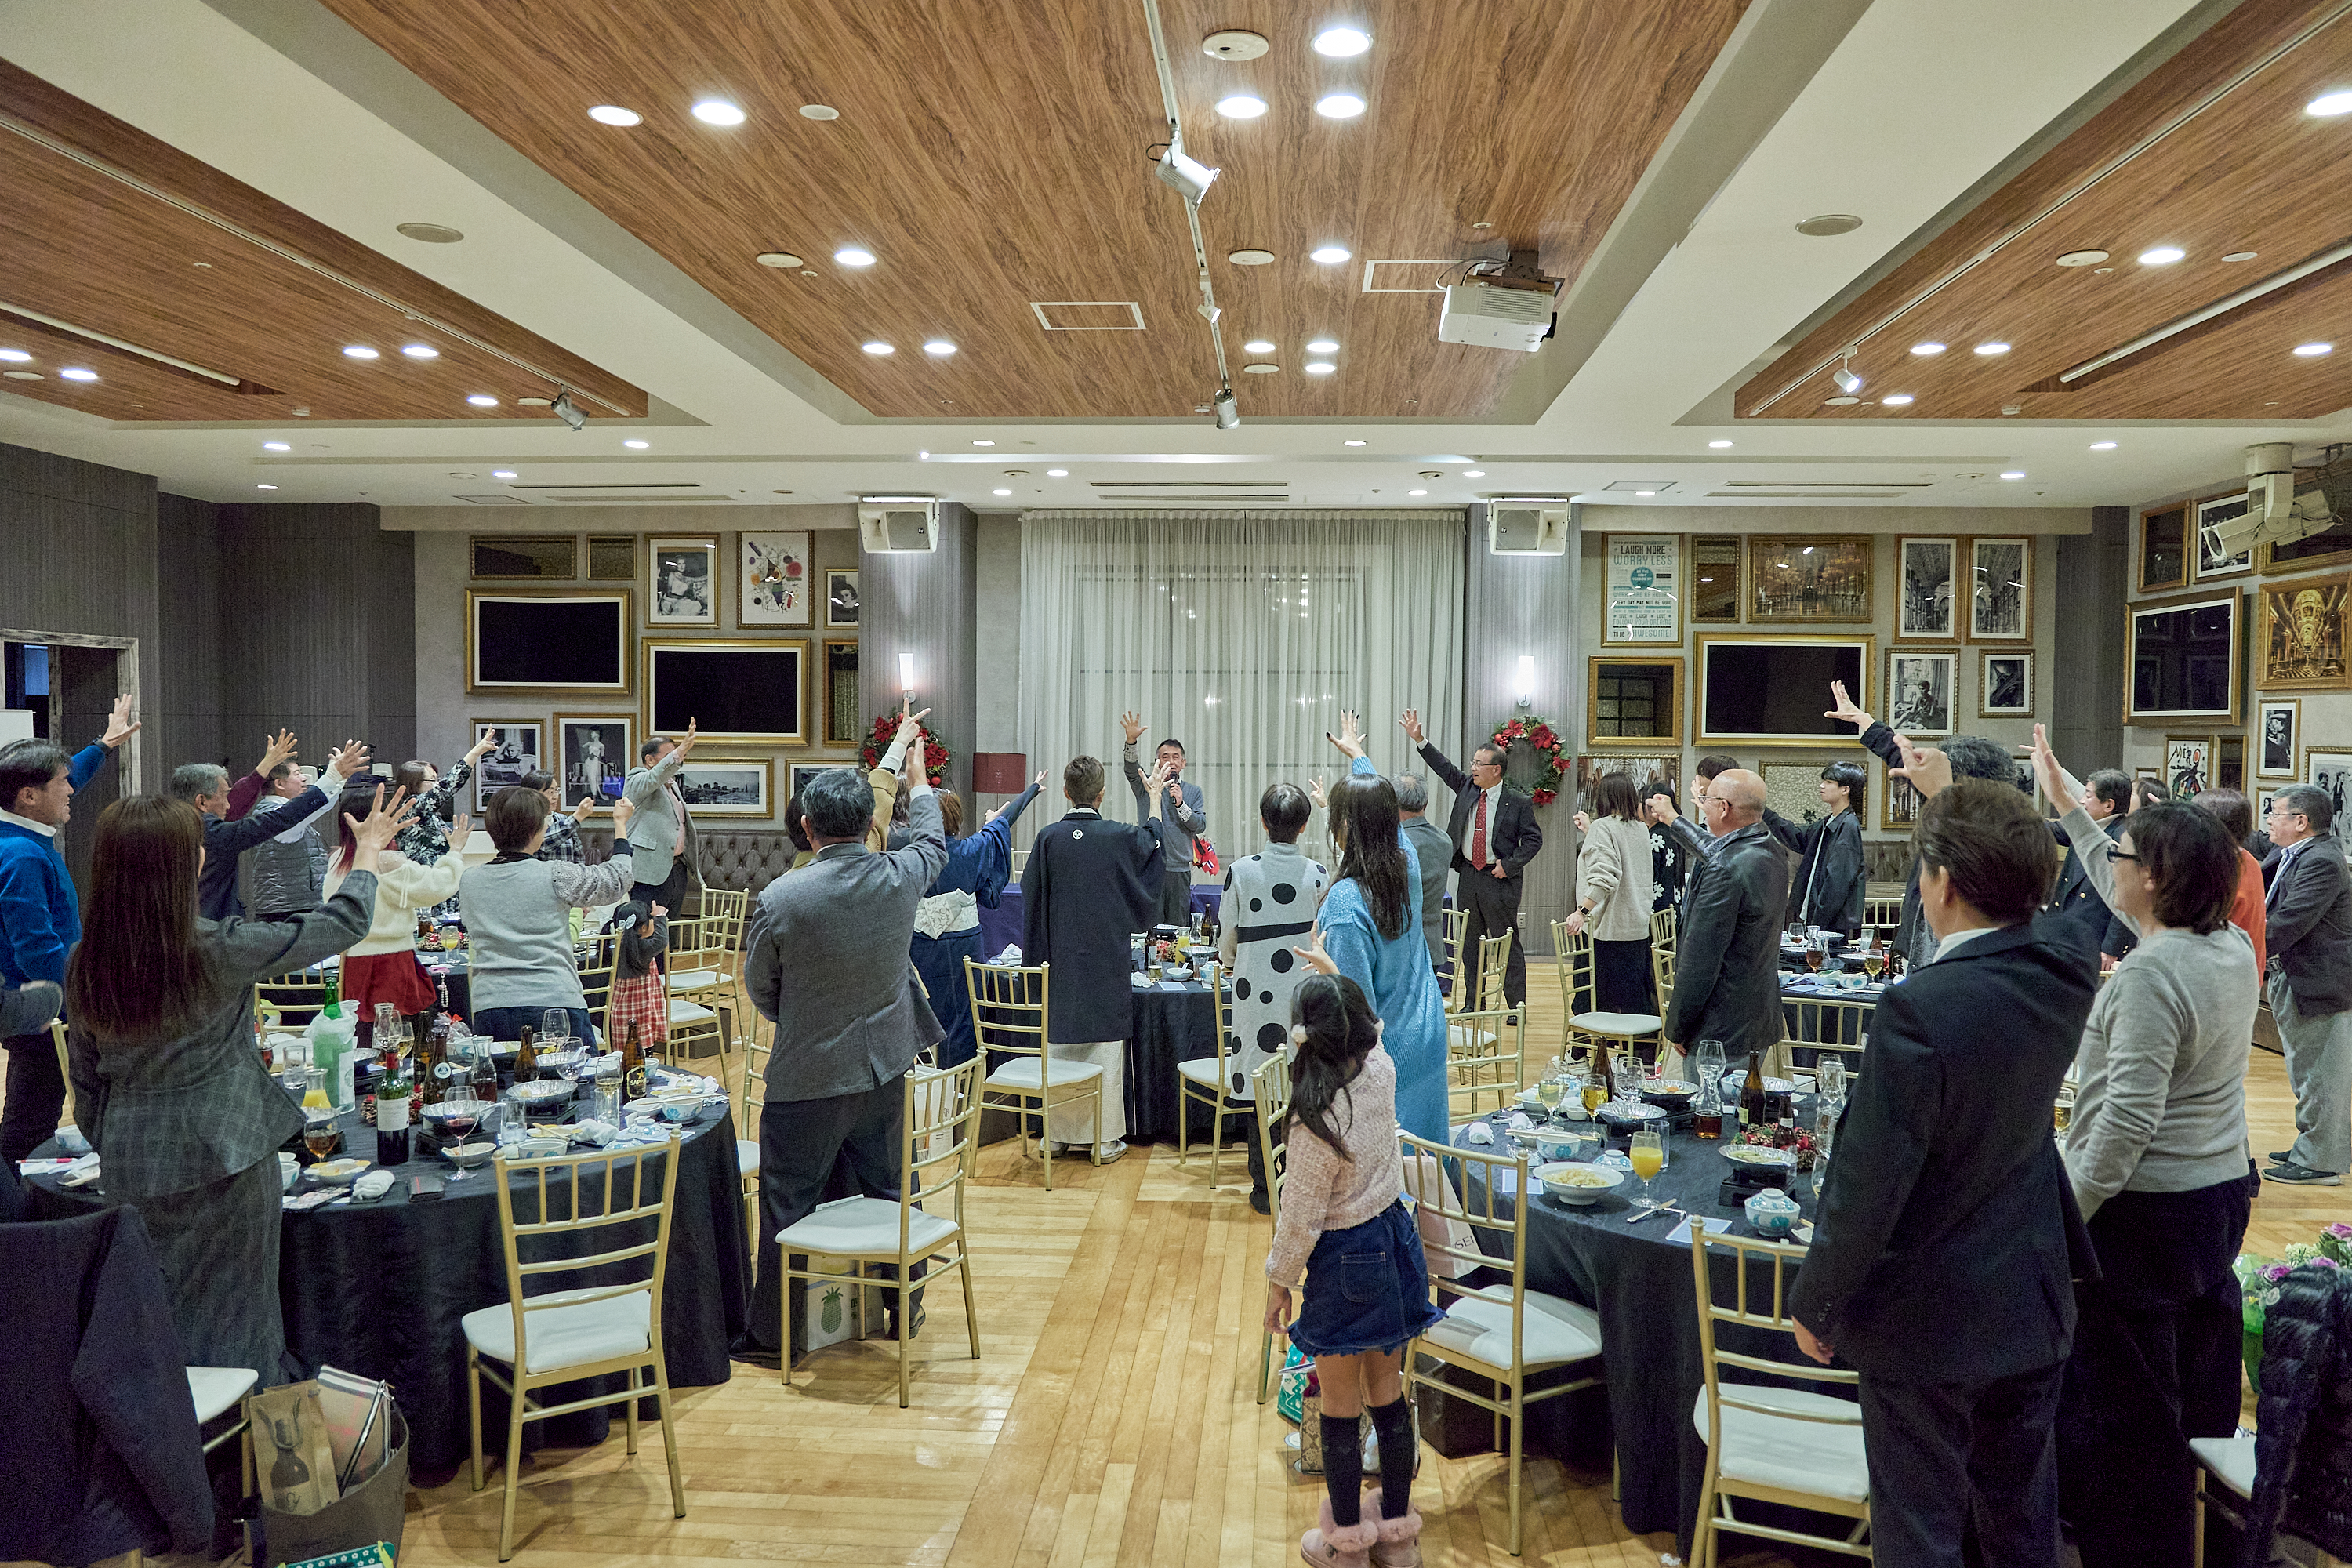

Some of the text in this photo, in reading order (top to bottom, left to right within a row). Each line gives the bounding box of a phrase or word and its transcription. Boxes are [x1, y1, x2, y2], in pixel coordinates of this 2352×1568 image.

[1621, 545, 1666, 554] LAUGH MORE
[1614, 555, 1673, 565] WORRY LESS
